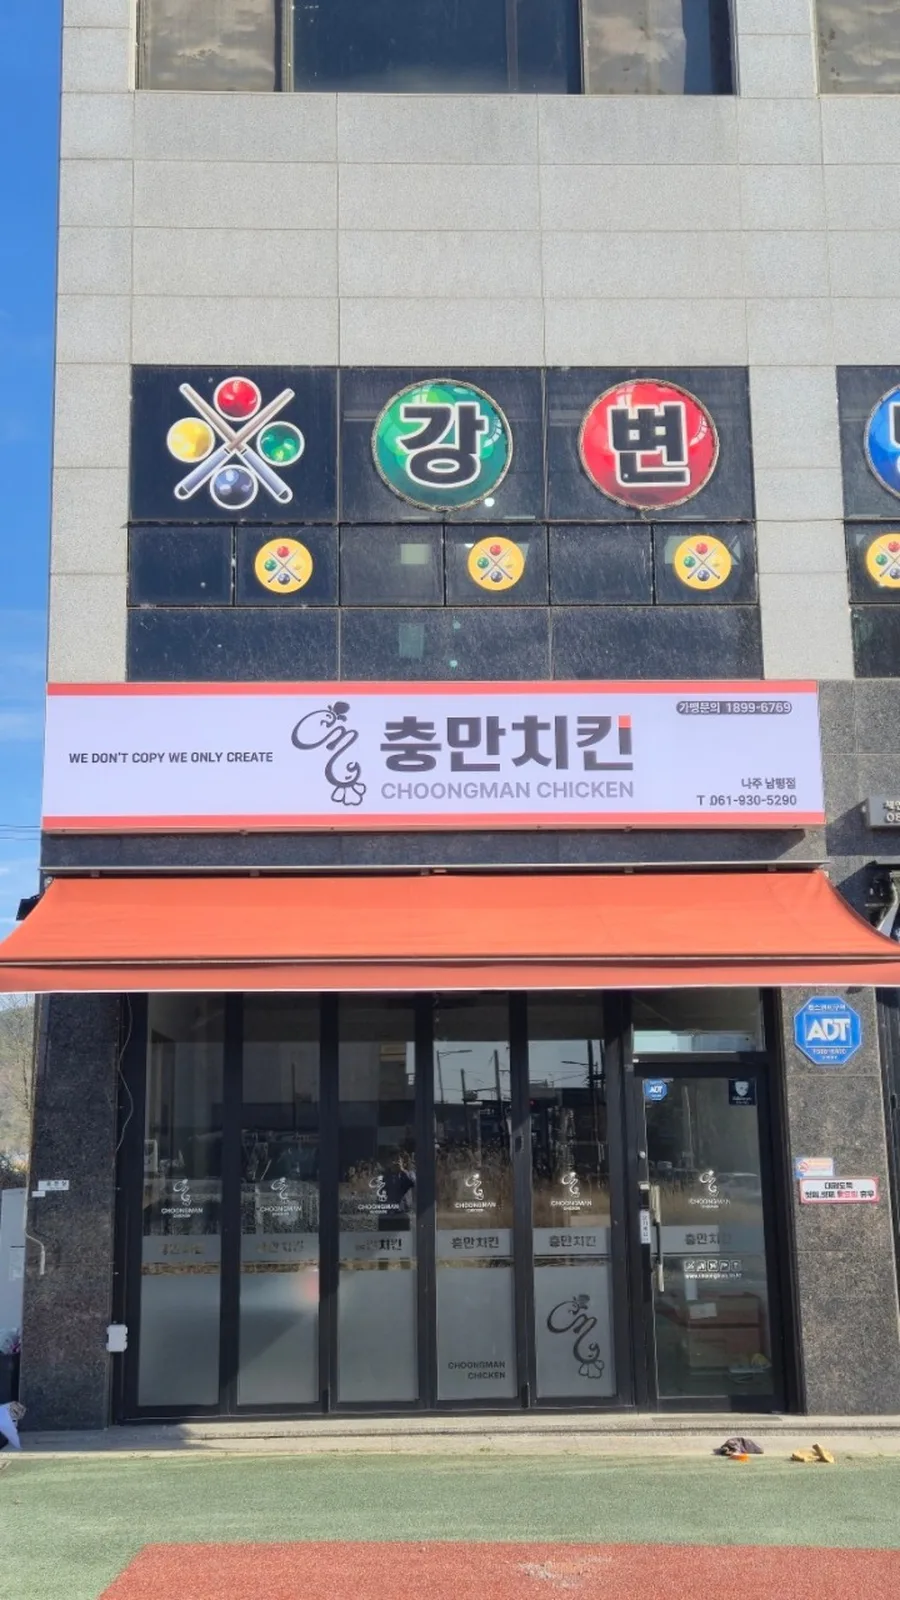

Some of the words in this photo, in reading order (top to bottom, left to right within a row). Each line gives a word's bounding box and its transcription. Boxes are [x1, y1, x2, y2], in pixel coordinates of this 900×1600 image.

[398, 400, 488, 491] 강
[608, 399, 692, 489] 변
[727, 702, 791, 713] 1899-6769
[380, 715, 634, 773] 충만치킨
[68, 752, 88, 764] WE
[91, 752, 129, 764] DON'T
[131, 752, 164, 764] COPY
[168, 752, 188, 764] WE
[190, 752, 224, 764] ONLY
[226, 752, 274, 764] CREATE
[740, 777, 763, 789] 나주
[765, 777, 796, 789] 남평점
[381, 782, 530, 800] CHOONGMAN
[537, 781, 634, 799] CHICKEN
[806, 1018, 851, 1041] ADT
[448, 1361, 506, 1369] CHOONGMAN
[467, 1372, 506, 1380] CHICKEN
